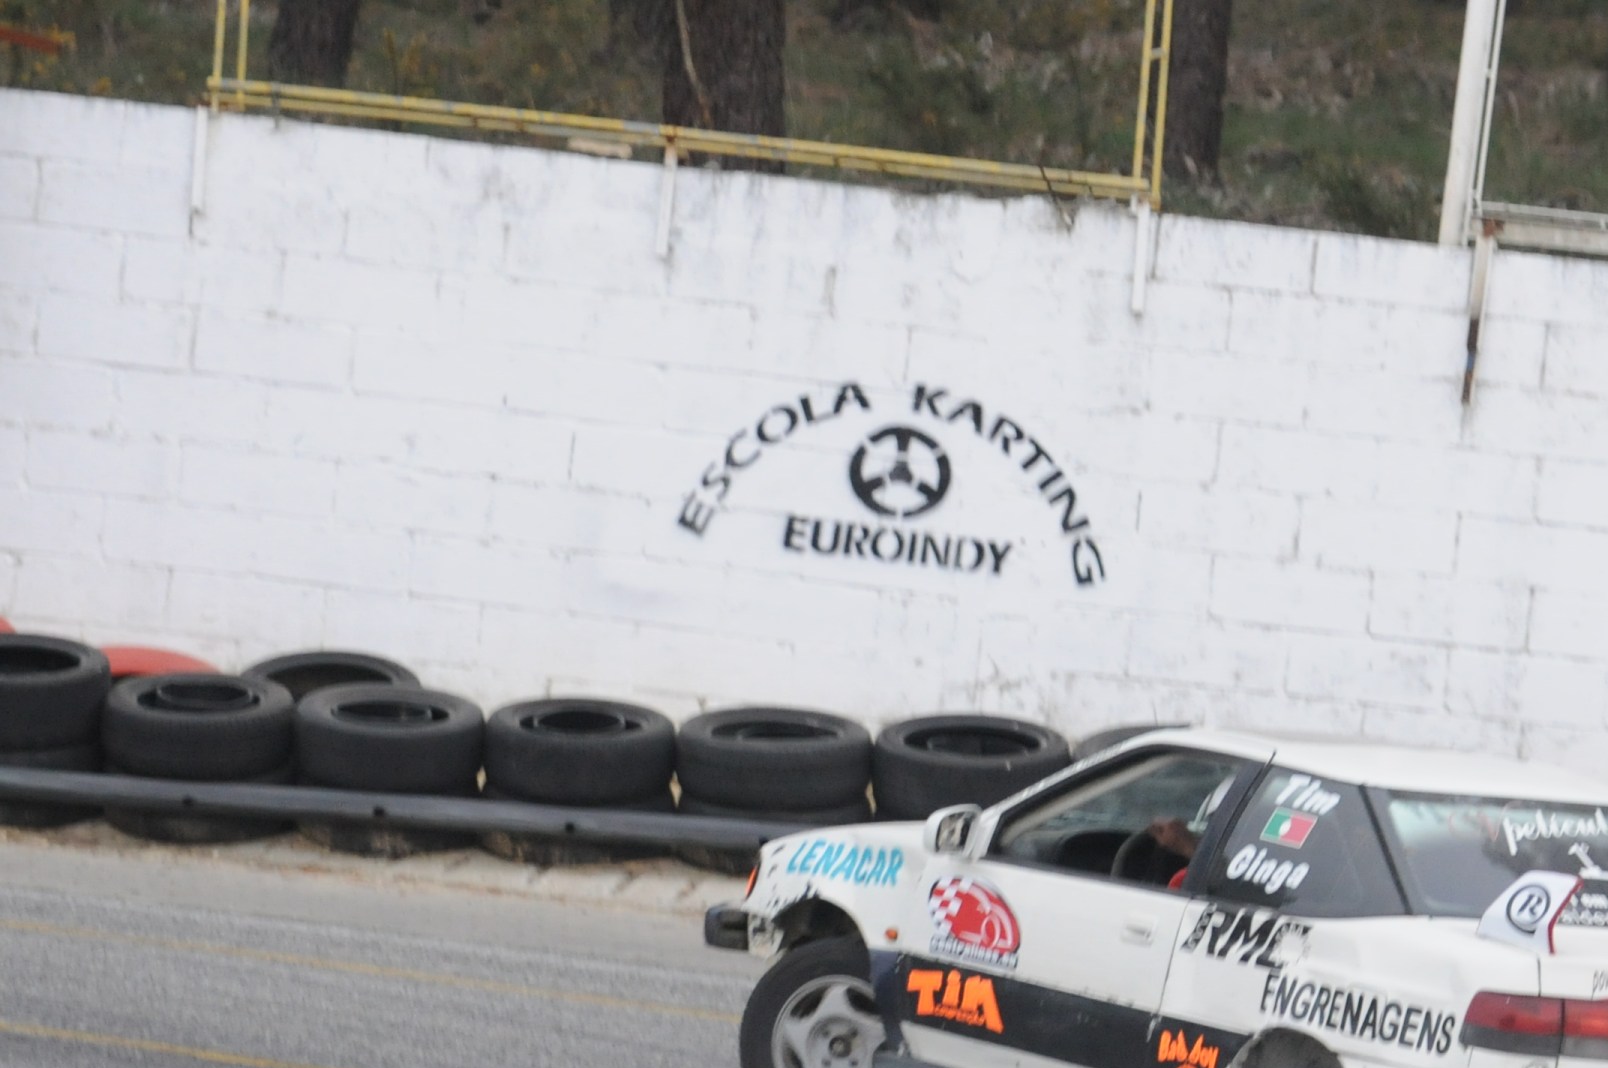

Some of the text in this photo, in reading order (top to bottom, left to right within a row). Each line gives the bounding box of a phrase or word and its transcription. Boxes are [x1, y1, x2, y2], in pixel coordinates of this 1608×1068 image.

[677, 380, 1106, 587] ESCOLA KARTING
[782, 514, 1013, 577] EUROINDY
[1274, 773, 1341, 816] Tim
[786, 838, 904, 887] LENACAR
[1226, 844, 1310, 894] Ginga
[1260, 969, 1456, 1056] ENGRENAGENS
